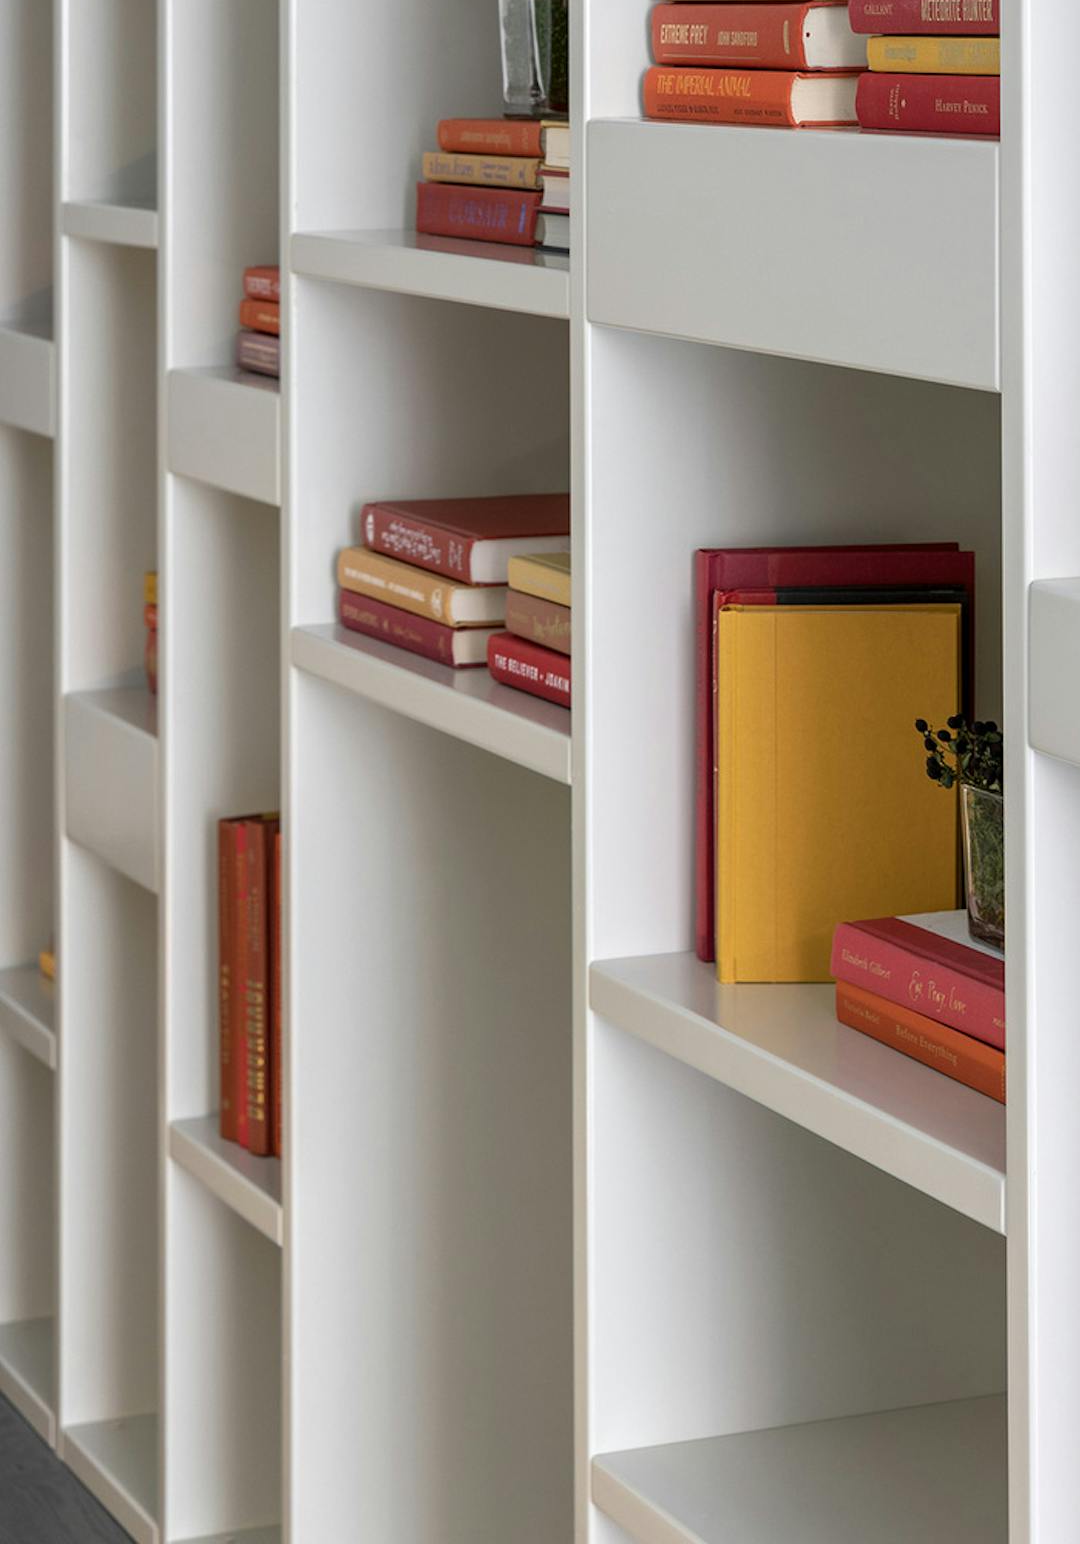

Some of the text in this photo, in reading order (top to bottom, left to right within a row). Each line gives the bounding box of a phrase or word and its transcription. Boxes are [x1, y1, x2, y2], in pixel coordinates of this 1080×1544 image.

[660, 24, 689, 44] EXTREME
[690, 24, 709, 44] PREY
[657, 75, 751, 97] THE IMPERIAL ANIMAL
[935, 99, 961, 113] HARVEY
[494, 654, 508, 670] THE
[508, 657, 539, 681] BELIEVER
